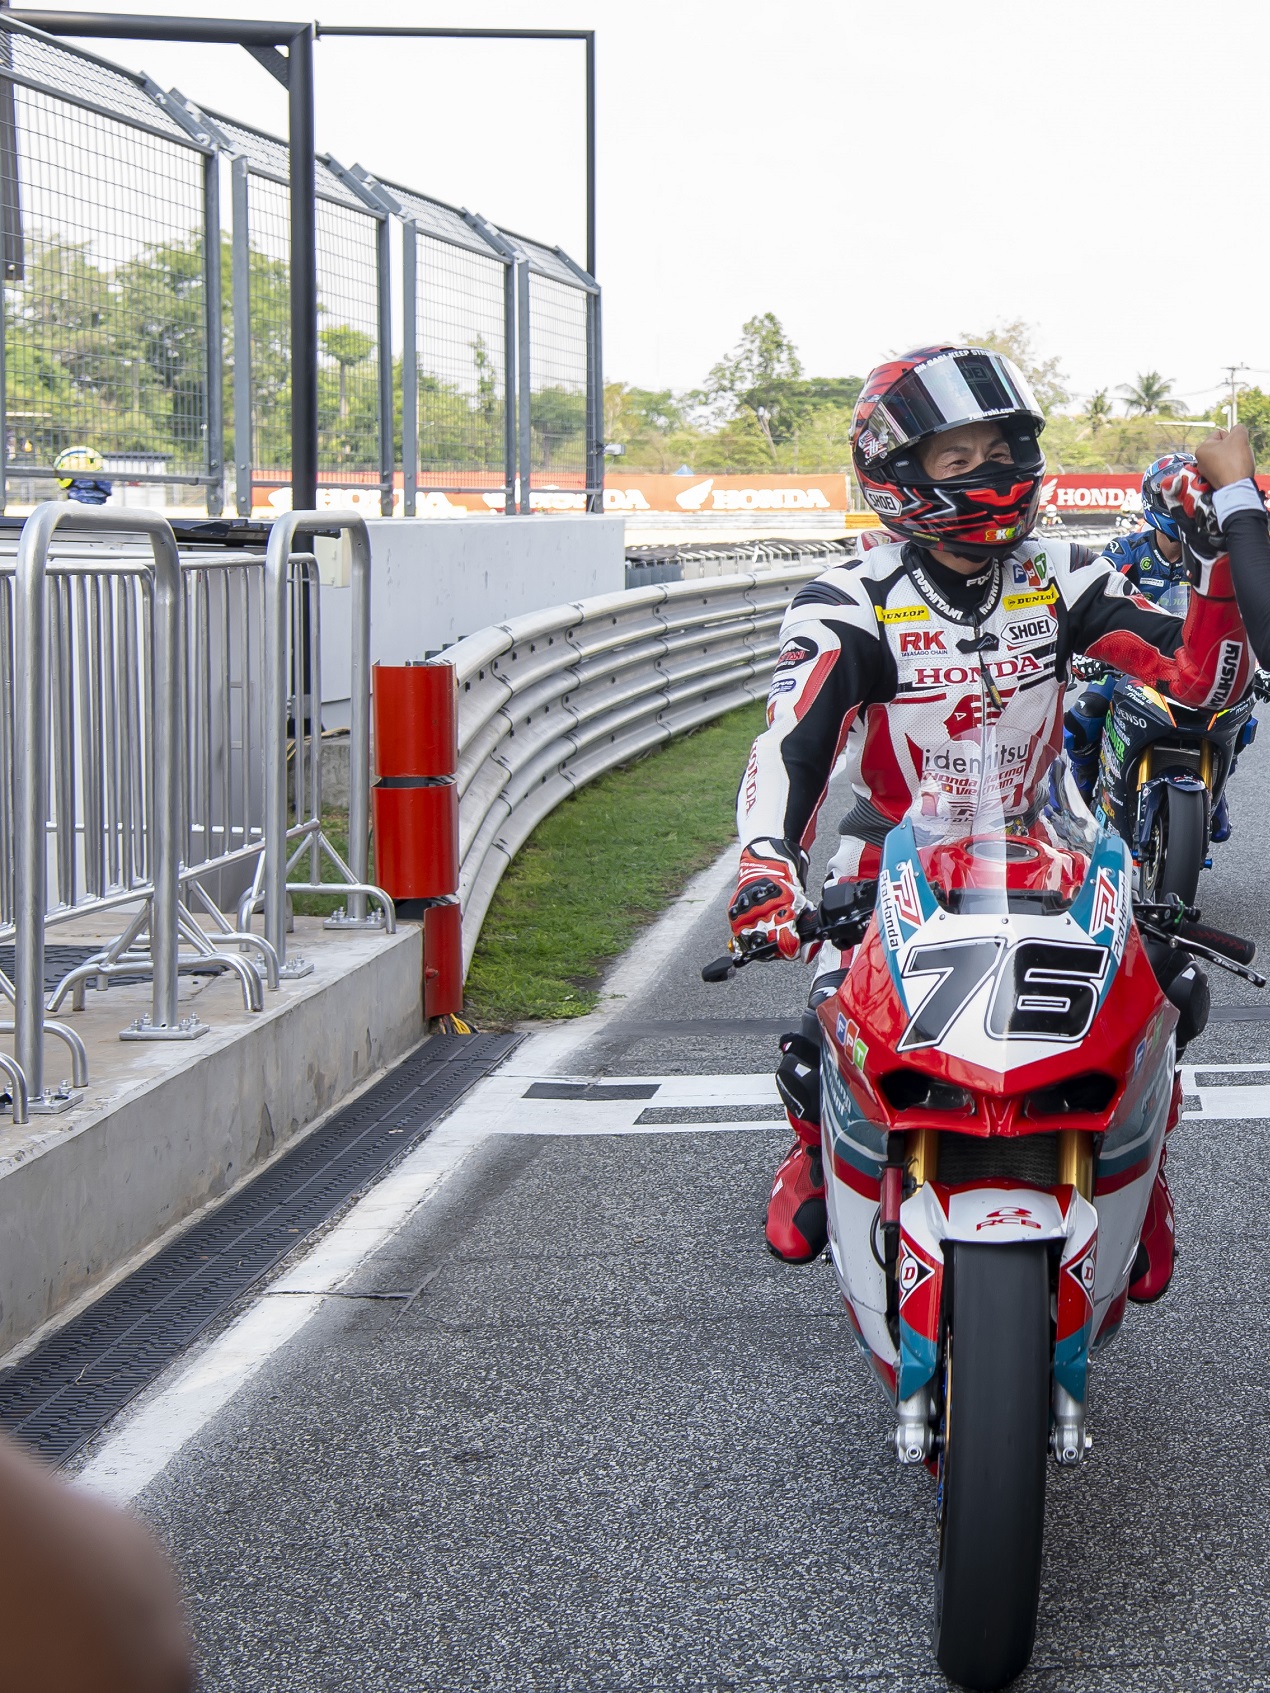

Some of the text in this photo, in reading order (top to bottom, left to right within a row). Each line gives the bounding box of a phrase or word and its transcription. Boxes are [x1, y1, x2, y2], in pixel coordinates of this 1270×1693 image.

[711, 489, 830, 509] HONDA
[869, 493, 897, 513] SHOEI
[1009, 619, 1050, 640] SHOEI
[899, 631, 947, 652] RK
[914, 655, 1042, 685] HONDA
[897, 935, 1110, 1054] 76
[903, 1267, 916, 1281] D
